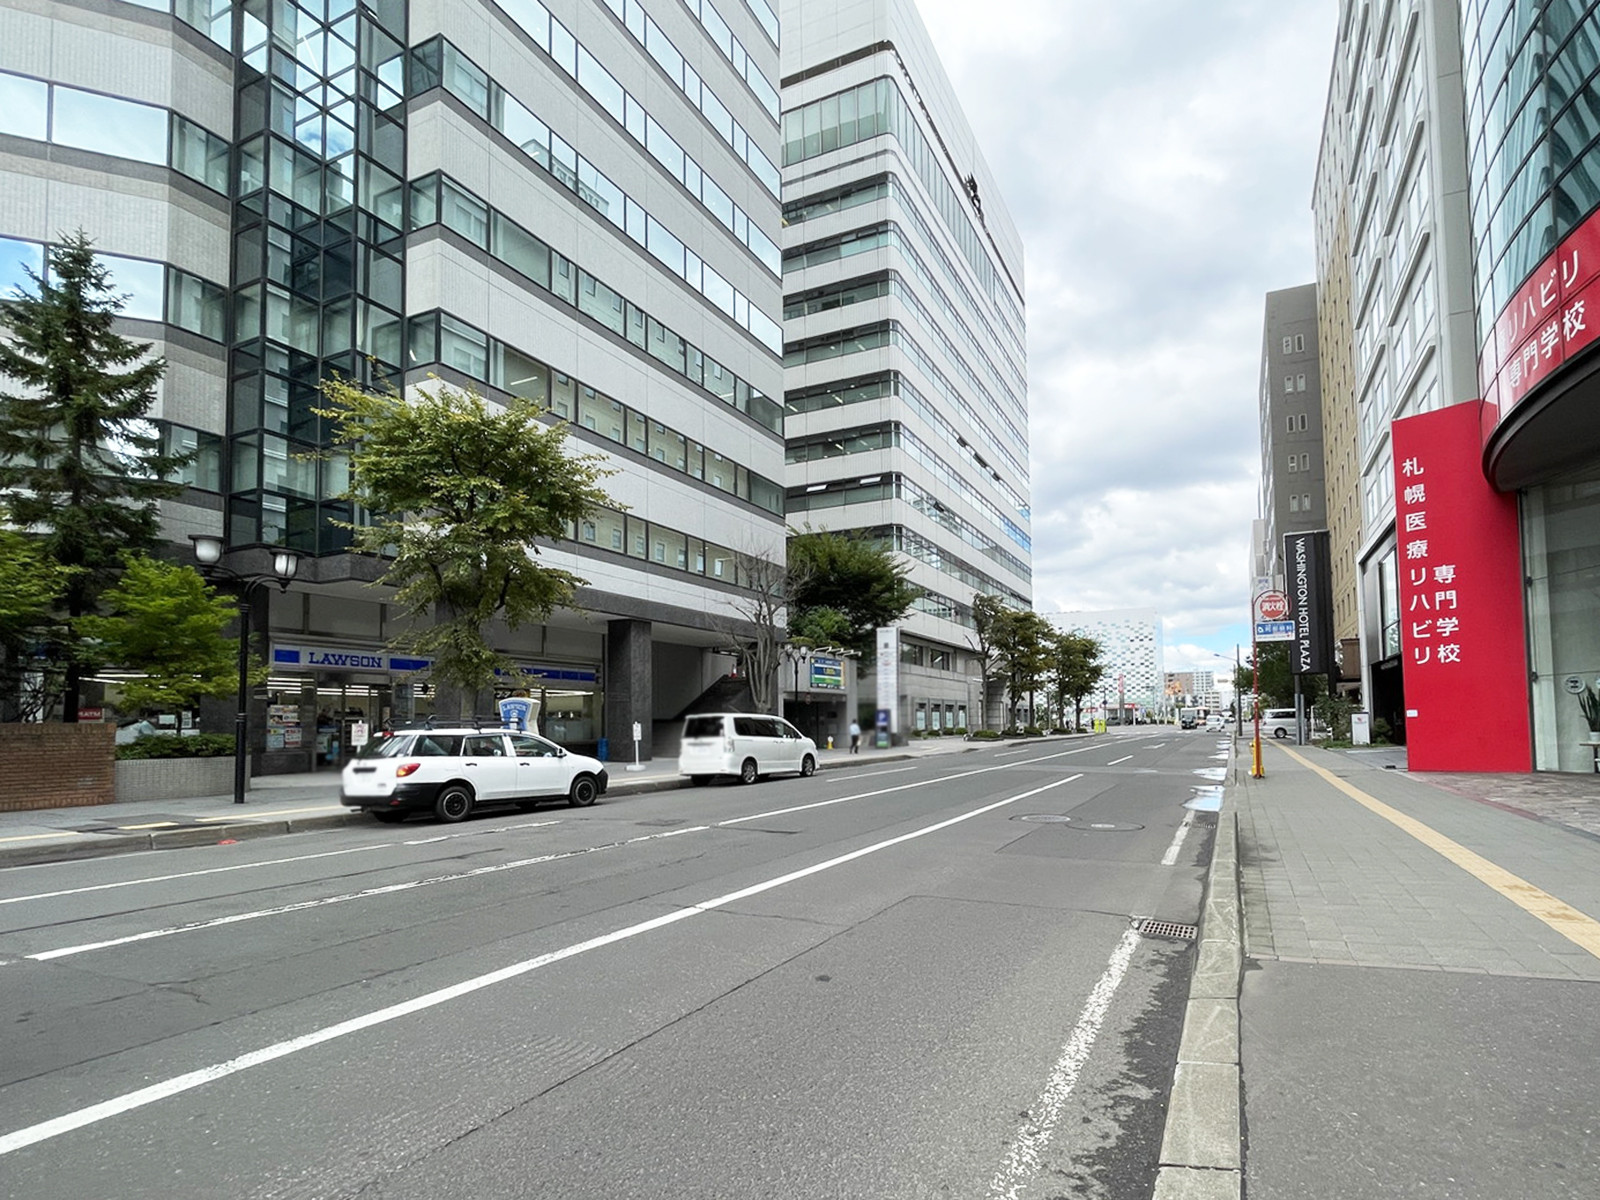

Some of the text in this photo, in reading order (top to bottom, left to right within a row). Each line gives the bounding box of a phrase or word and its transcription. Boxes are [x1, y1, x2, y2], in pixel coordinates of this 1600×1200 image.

[1508, 300, 1586, 387] 専門学校
[1295, 537, 1311, 672] WASHINGTON HOTEL PLAZA
[1402, 457, 1432, 665] 札幌医療リハビリ
[308, 652, 383, 668] LAWSON
[1433, 564, 1461, 664] 専門学校
